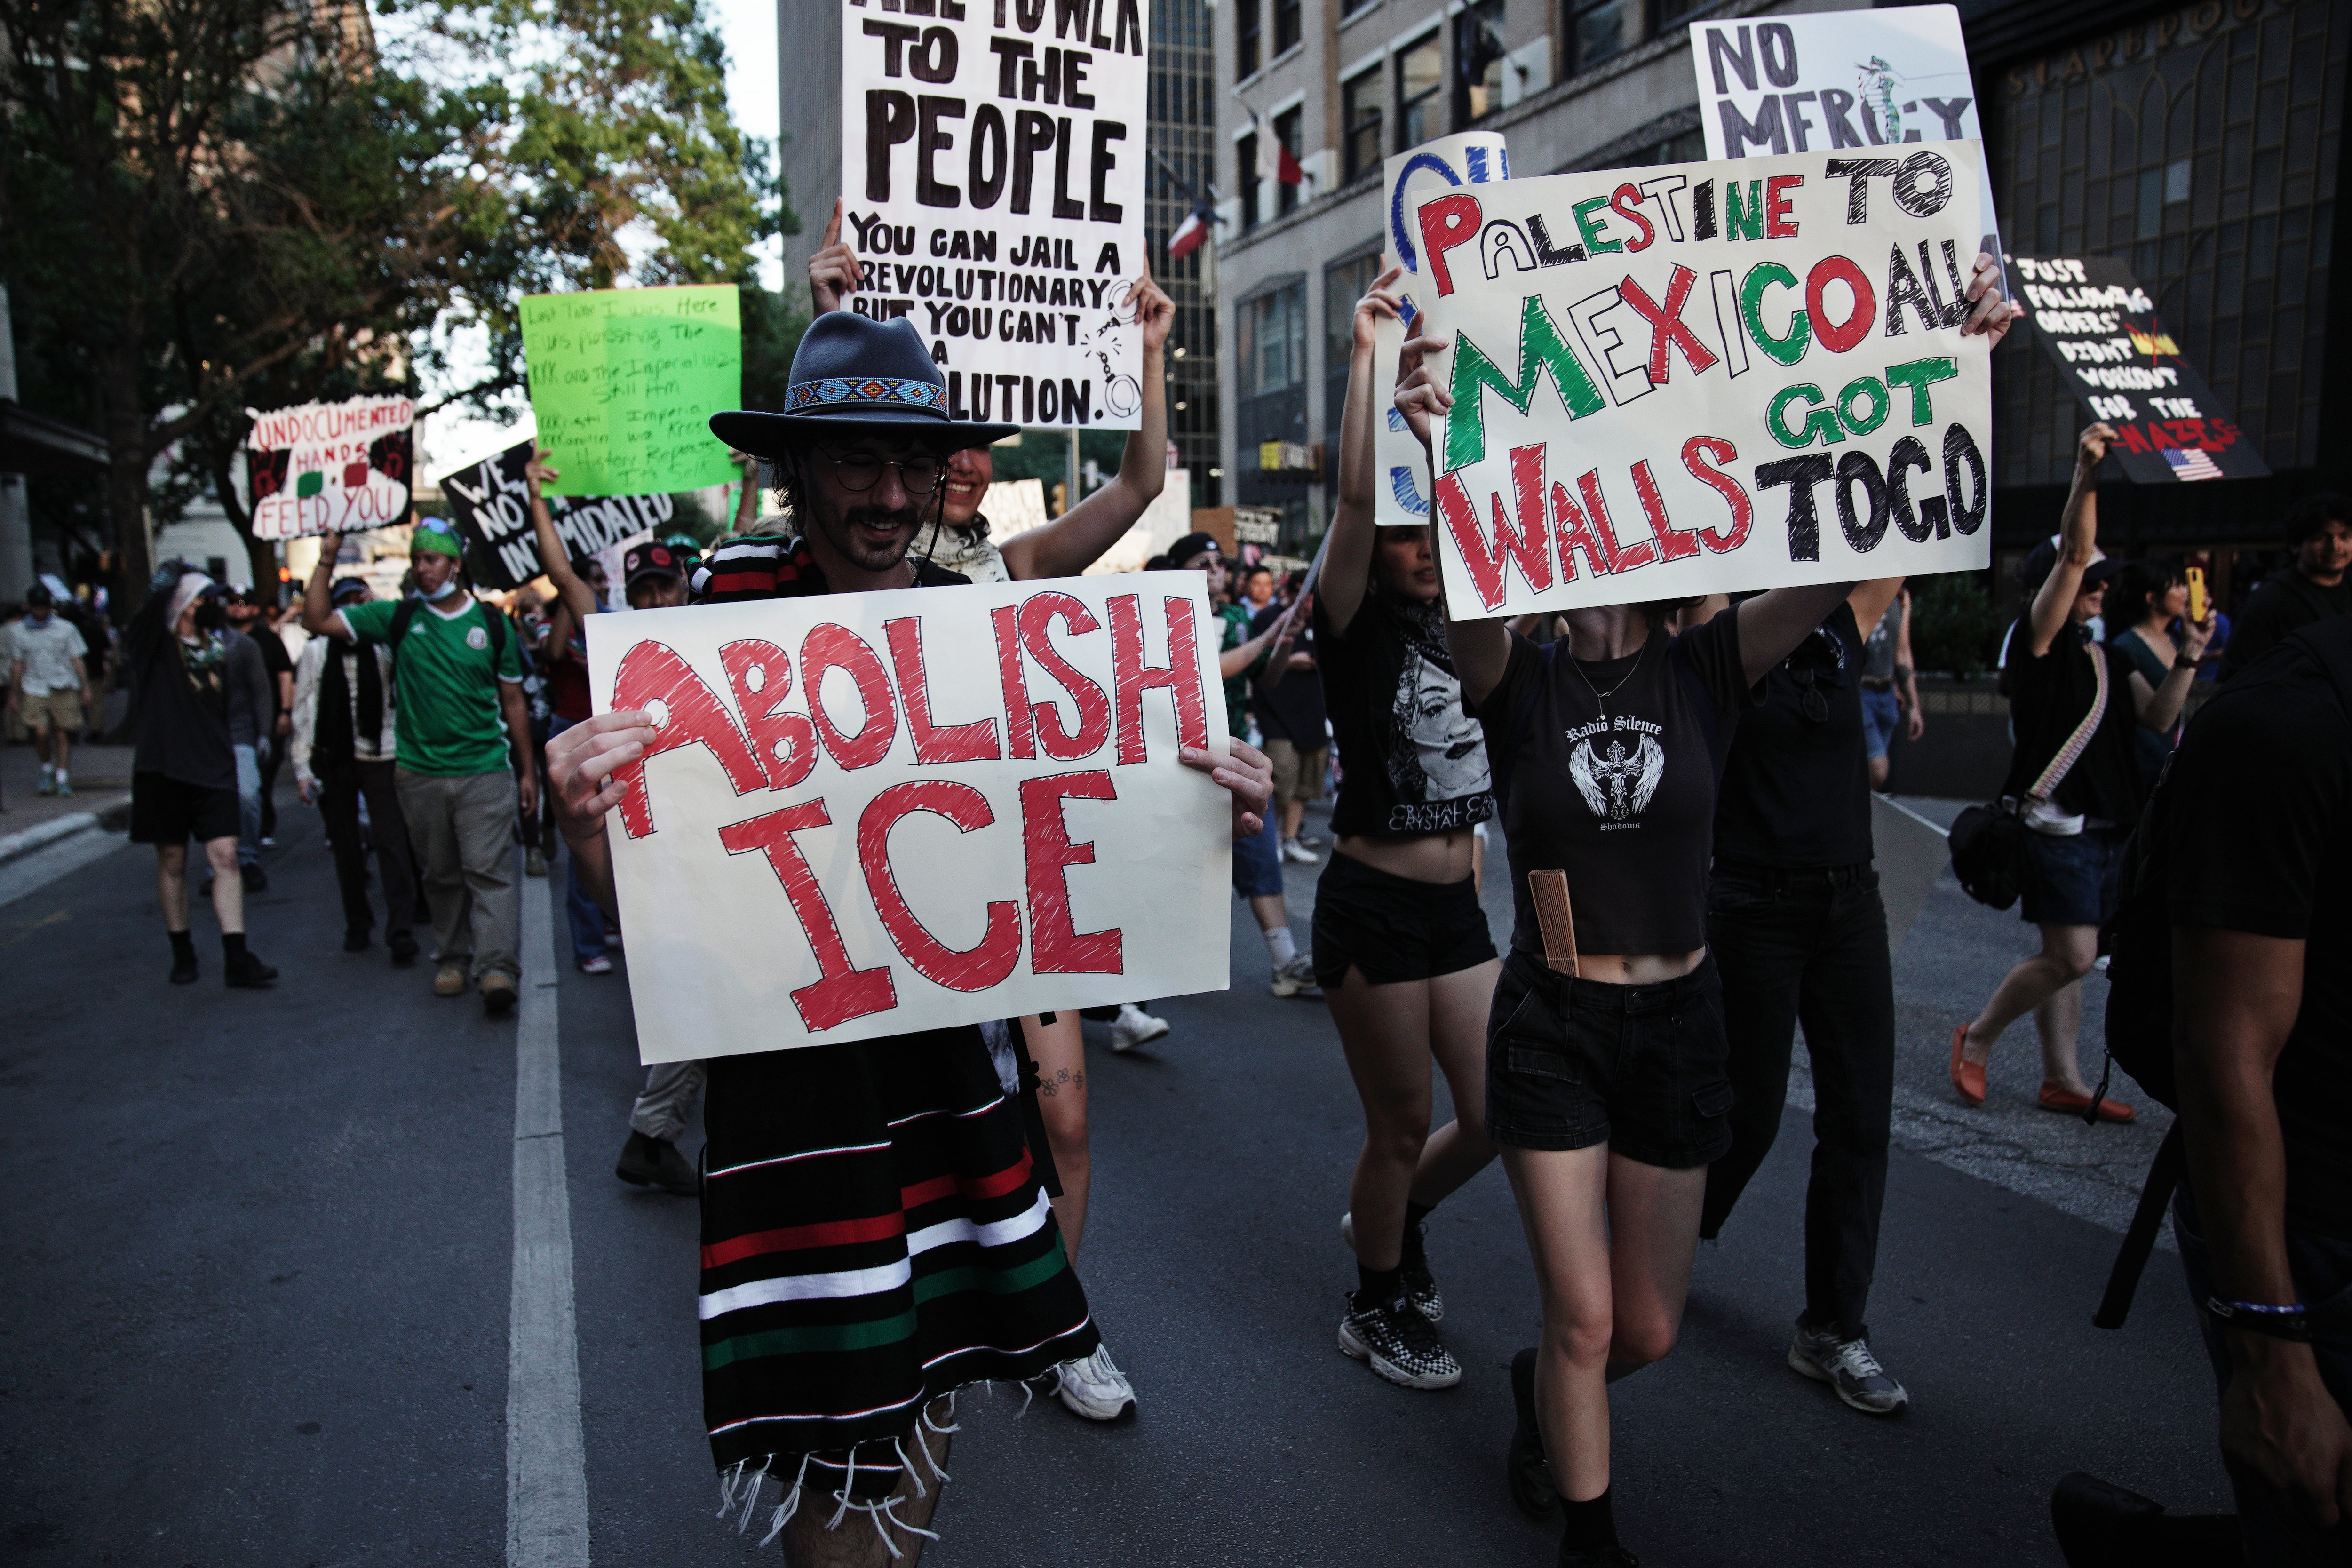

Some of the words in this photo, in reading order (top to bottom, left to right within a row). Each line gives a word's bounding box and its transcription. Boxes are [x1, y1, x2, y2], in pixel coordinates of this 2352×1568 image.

[863, 18, 959, 84] TO
[991, 36, 1095, 110] THE
[1706, 23, 1798, 94] NO
[866, 89, 1127, 224] PEOPLE
[848, 211, 915, 255] YOU
[930, 228, 997, 262] CAN
[1010, 236, 1078, 271] JAIL
[1095, 243, 1121, 275] A
[1418, 175, 1804, 297] PALESTINE
[1826, 151, 1953, 225] TO
[676, 296, 718, 316] Here
[857, 260, 1110, 309] REVOLUTIONARY
[853, 297, 914, 323] BUT
[924, 301, 992, 339] YOU
[999, 309, 1080, 346] CAN'T
[931, 340, 949, 365] A
[1444, 255, 1875, 473] MEXICO
[1885, 239, 1974, 337] ALL
[938, 371, 1103, 424] LUTION.
[1766, 356, 1957, 448] GOT
[2088, 394, 2137, 421] FOR
[2148, 397, 2202, 419] THE
[255, 401, 413, 449] UNDOCUMENTED
[296, 441, 367, 470] HANDS
[449, 452, 517, 504] WE
[260, 494, 329, 535] FEED
[339, 486, 391, 531] YOU
[1435, 436, 1753, 613] WALLS
[609, 591, 1208, 839] ABOLISH
[1565, 718, 1609, 743] Radio
[1613, 715, 1662, 735] Silence
[1392, 801, 1462, 819] CRYSTAL
[1600, 823, 1640, 831] Shadows
[719, 770, 1123, 1033] ICE
